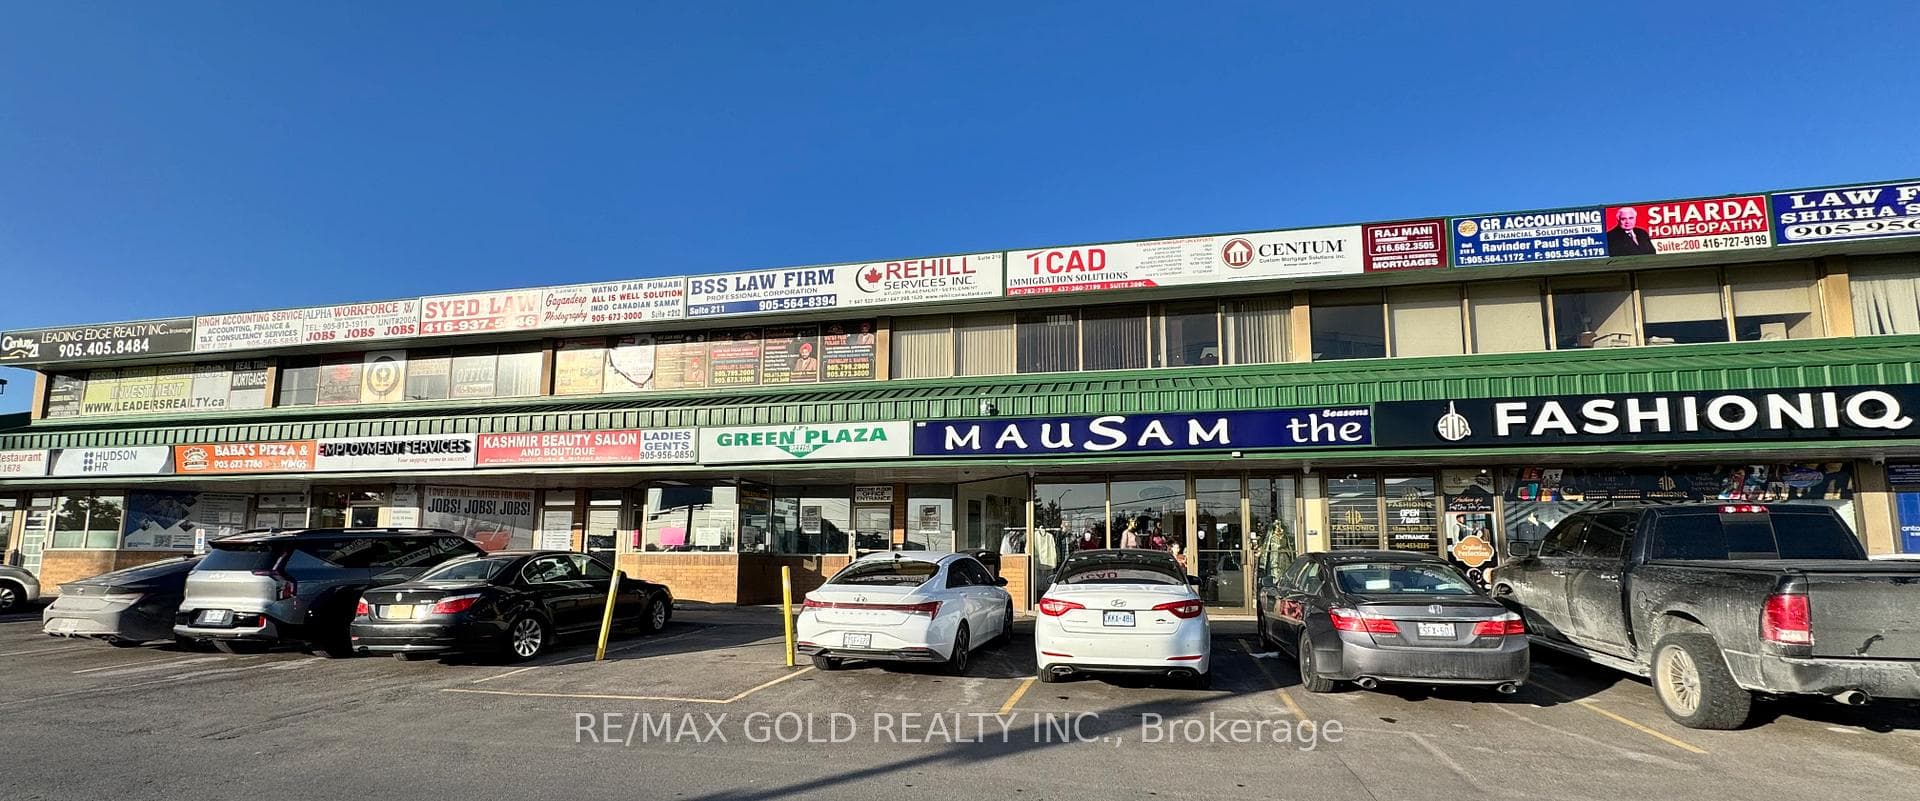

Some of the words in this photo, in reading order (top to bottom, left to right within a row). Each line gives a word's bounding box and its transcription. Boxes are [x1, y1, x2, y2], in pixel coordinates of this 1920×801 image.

[1790, 188, 1883, 209] LAW
[1648, 199, 1763, 225] SHARDA
[1781, 205, 1898, 225] SHIKHA
[1481, 218, 1501, 230] GR
[1505, 211, 1602, 228] ACCOUNTING
[1649, 218, 1764, 237] HOMEOPATHY
[1375, 228, 1399, 238] RAJ
[1401, 225, 1433, 236] MANI
[1259, 239, 1344, 257] CENTUM
[1482, 240, 1531, 252] Ravinder
[1534, 238, 1560, 250] Paul
[1657, 240, 1701, 252] Suite:200
[1702, 235, 1768, 249] 416-727-9199
[886, 257, 976, 280] REHILL
[1372, 258, 1439, 269] MORTGAGES
[592, 286, 618, 294] WATNO
[647, 280, 682, 290] PUNJABI
[691, 278, 728, 295] BSS
[735, 273, 777, 292] LAW
[784, 269, 835, 287] FIRM
[884, 277, 946, 291] SERVICES
[952, 275, 976, 285] INC.
[1010, 275, 1074, 287] IMMIGRATION
[1075, 272, 1128, 282] SOLUTIONS
[1110, 281, 1128, 289] SUITE
[546, 293, 587, 310] Gagandeep
[592, 295, 606, 303] ALL
[608, 294, 617, 302] IS
[620, 292, 640, 301] WELL
[643, 289, 683, 299] SOLUTION
[706, 292, 761, 302] PROFESSIONAL
[764, 287, 818, 297] CORPORATION
[305, 308, 331, 320] ALPHA
[334, 302, 399, 318] WORKFORCE
[425, 298, 480, 319] SYED
[489, 296, 536, 315] LAW
[591, 303, 609, 312] INDO
[612, 300, 651, 311] CANADIAN
[654, 298, 680, 307] SAMAY
[689, 307, 709, 316] Suite
[711, 305, 725, 313] 211
[759, 296, 836, 311] 905-564-8394
[198, 318, 220, 327] SINGH
[223, 313, 269, 325] ACCOUNTING
[272, 310, 303, 320] SERVICE
[423, 315, 537, 333] 416-937-56
[544, 310, 588, 323] Photography
[591, 312, 643, 323] 905-673-3000
[42, 330, 83, 343] LEADING
[84, 328, 112, 341] EDGE
[113, 325, 147, 338] REALTY
[149, 323, 169, 336] INC.
[216, 332, 262, 341] CONSULTANCY
[264, 329, 298, 338] SERVICES
[253, 323, 283, 331] FINANCE
[306, 330, 336, 341] JOBS
[344, 327, 375, 338] JOBS
[384, 324, 415, 336] JOBS
[59, 338, 149, 358] 905.405.8484
[1322, 409, 1369, 417] Seasons
[1494, 391, 1912, 436] FASHIONIQ
[1286, 413, 1362, 443] the
[483, 434, 538, 448] KASHMIR
[542, 432, 592, 446] BEAUTY
[595, 432, 637, 445] SALON
[643, 431, 692, 442] LADIES
[717, 430, 795, 446] GREEN
[805, 427, 888, 444] PLAZA
[214, 444, 256, 457] BABA'S
[259, 443, 297, 456] PIZZA
[299, 445, 309, 456] &
[318, 441, 401, 456] EMPLOYMENT
[404, 439, 466, 454] SERVICES
[520, 448, 542, 457] AND
[543, 446, 595, 457] BOUTIQUE
[644, 441, 690, 451] GENTS
[0, 452, 42, 463] estaurant
[95, 450, 137, 461] HUDSON
[640, 450, 695, 460] 905-956-0850
[3, 464, 21, 472] 1678
[94, 462, 109, 472] HR
[281, 459, 307, 469] WINGS
[428, 498, 460, 513] JOBS!
[464, 499, 496, 514] JOBS!
[500, 500, 531, 516] JOBS!
